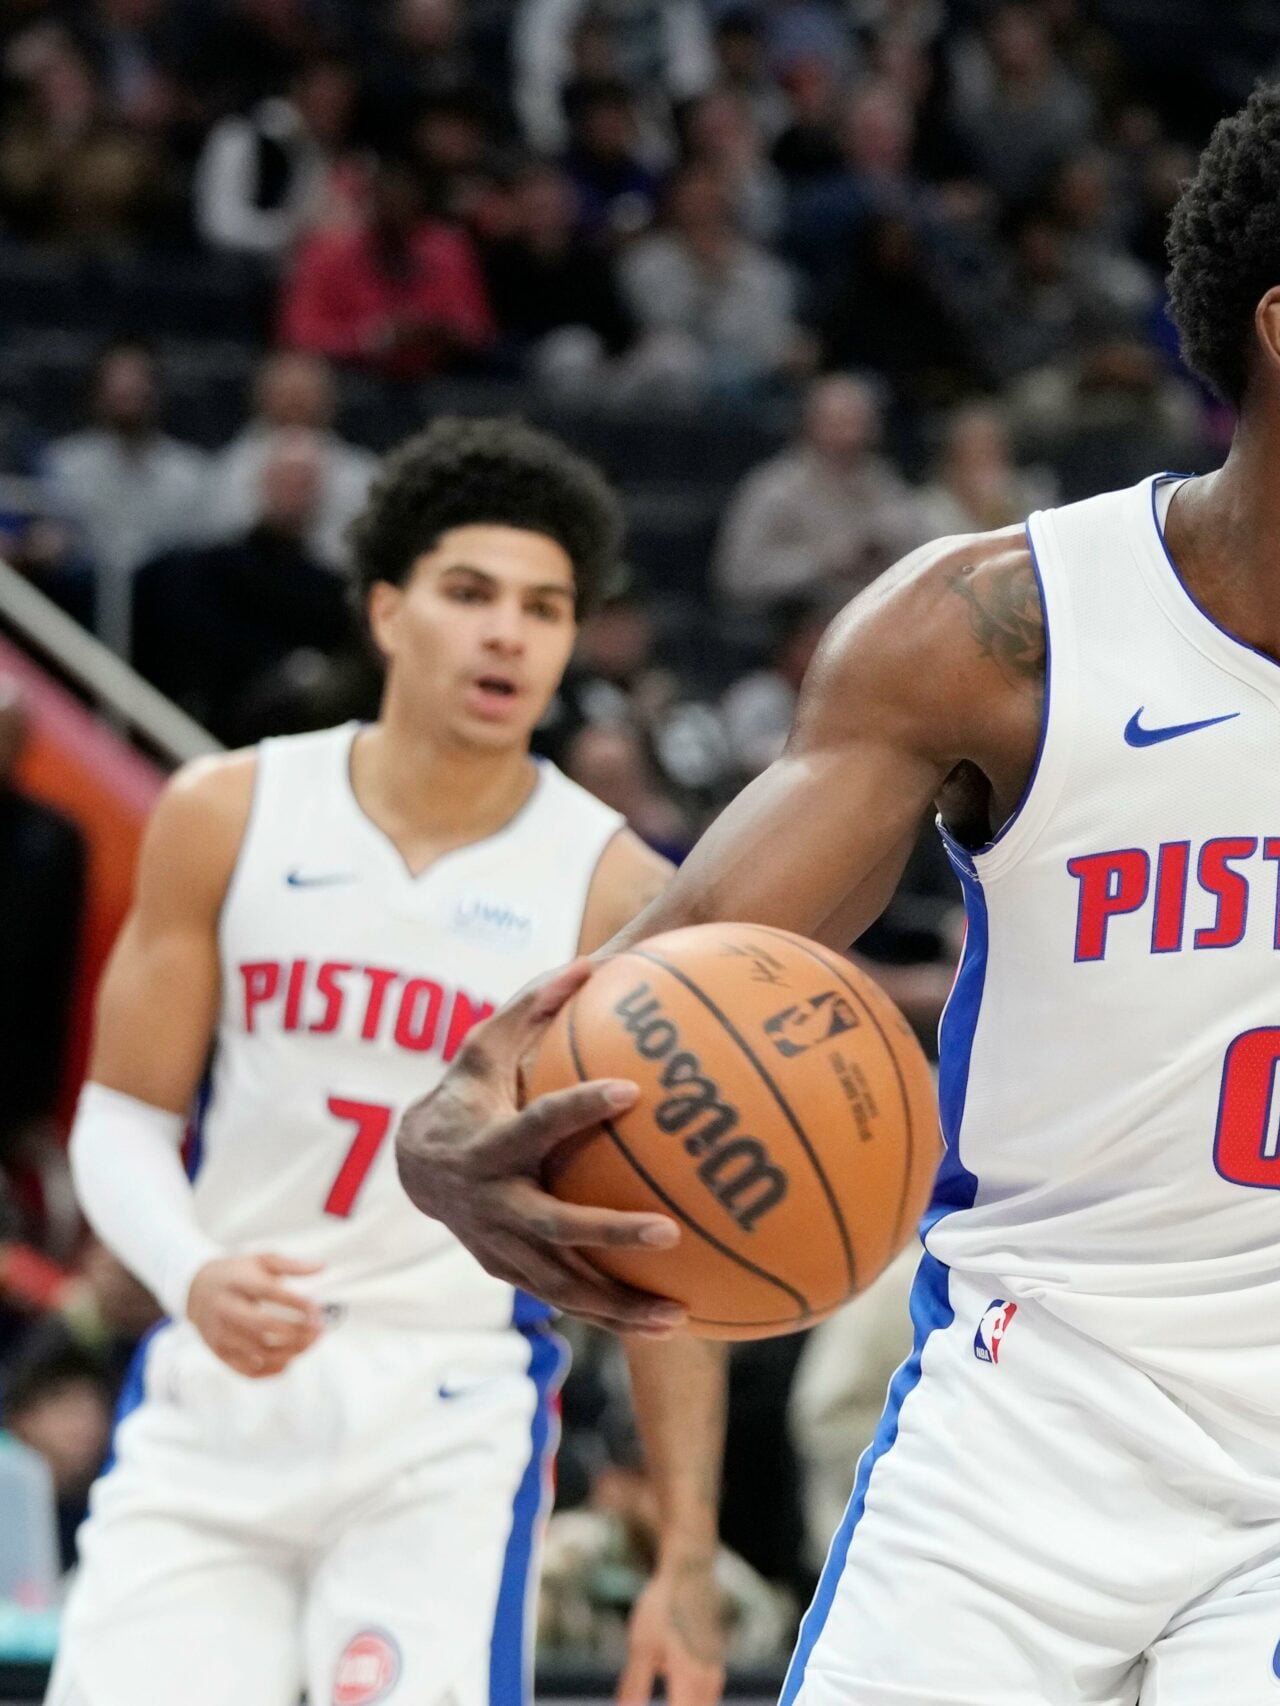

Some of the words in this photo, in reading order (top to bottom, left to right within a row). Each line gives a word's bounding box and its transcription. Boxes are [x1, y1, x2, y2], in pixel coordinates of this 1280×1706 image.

[238, 958, 497, 1063] PISTON
[323, 1095, 393, 1219] 7
[614, 981, 790, 1233] Wilson
